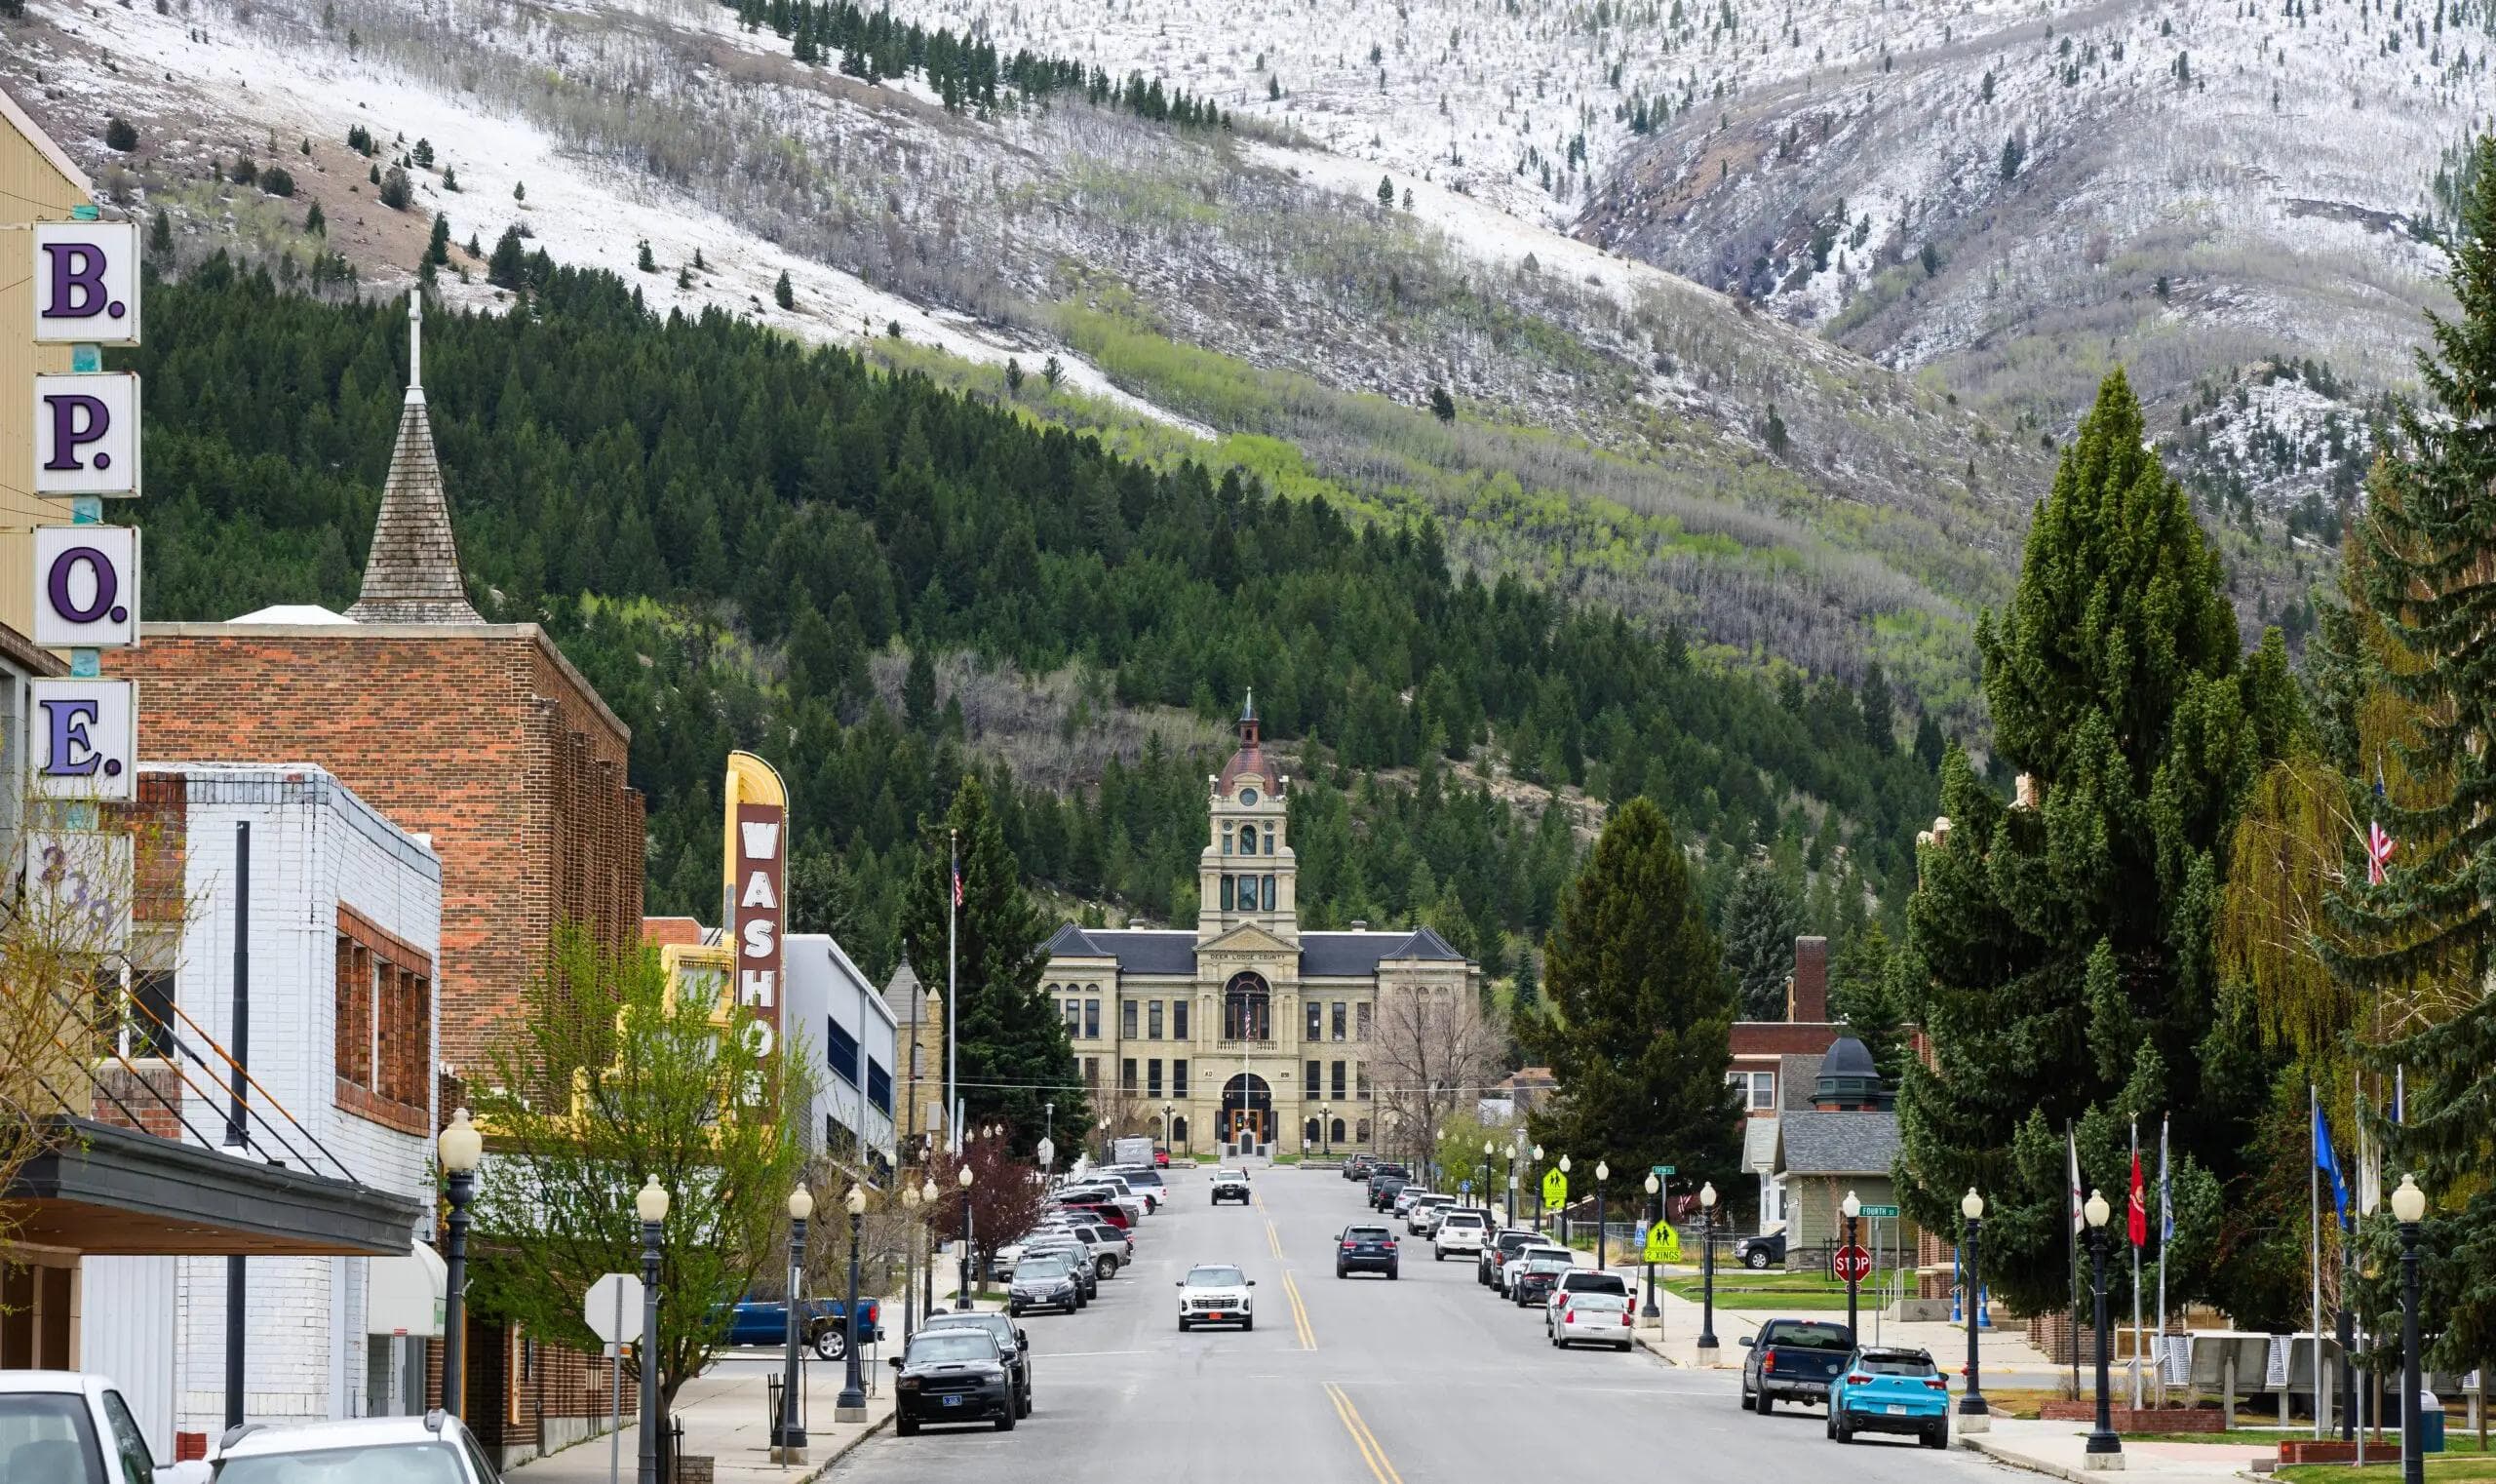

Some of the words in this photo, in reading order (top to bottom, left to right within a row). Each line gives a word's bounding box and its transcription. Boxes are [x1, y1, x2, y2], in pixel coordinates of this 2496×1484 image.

[1862, 1207, 1887, 1216] FOURTH
[1646, 1251, 1652, 1260] 2
[1656, 1251, 1679, 1260] XINGS
[1836, 1257, 1869, 1271] STOP
